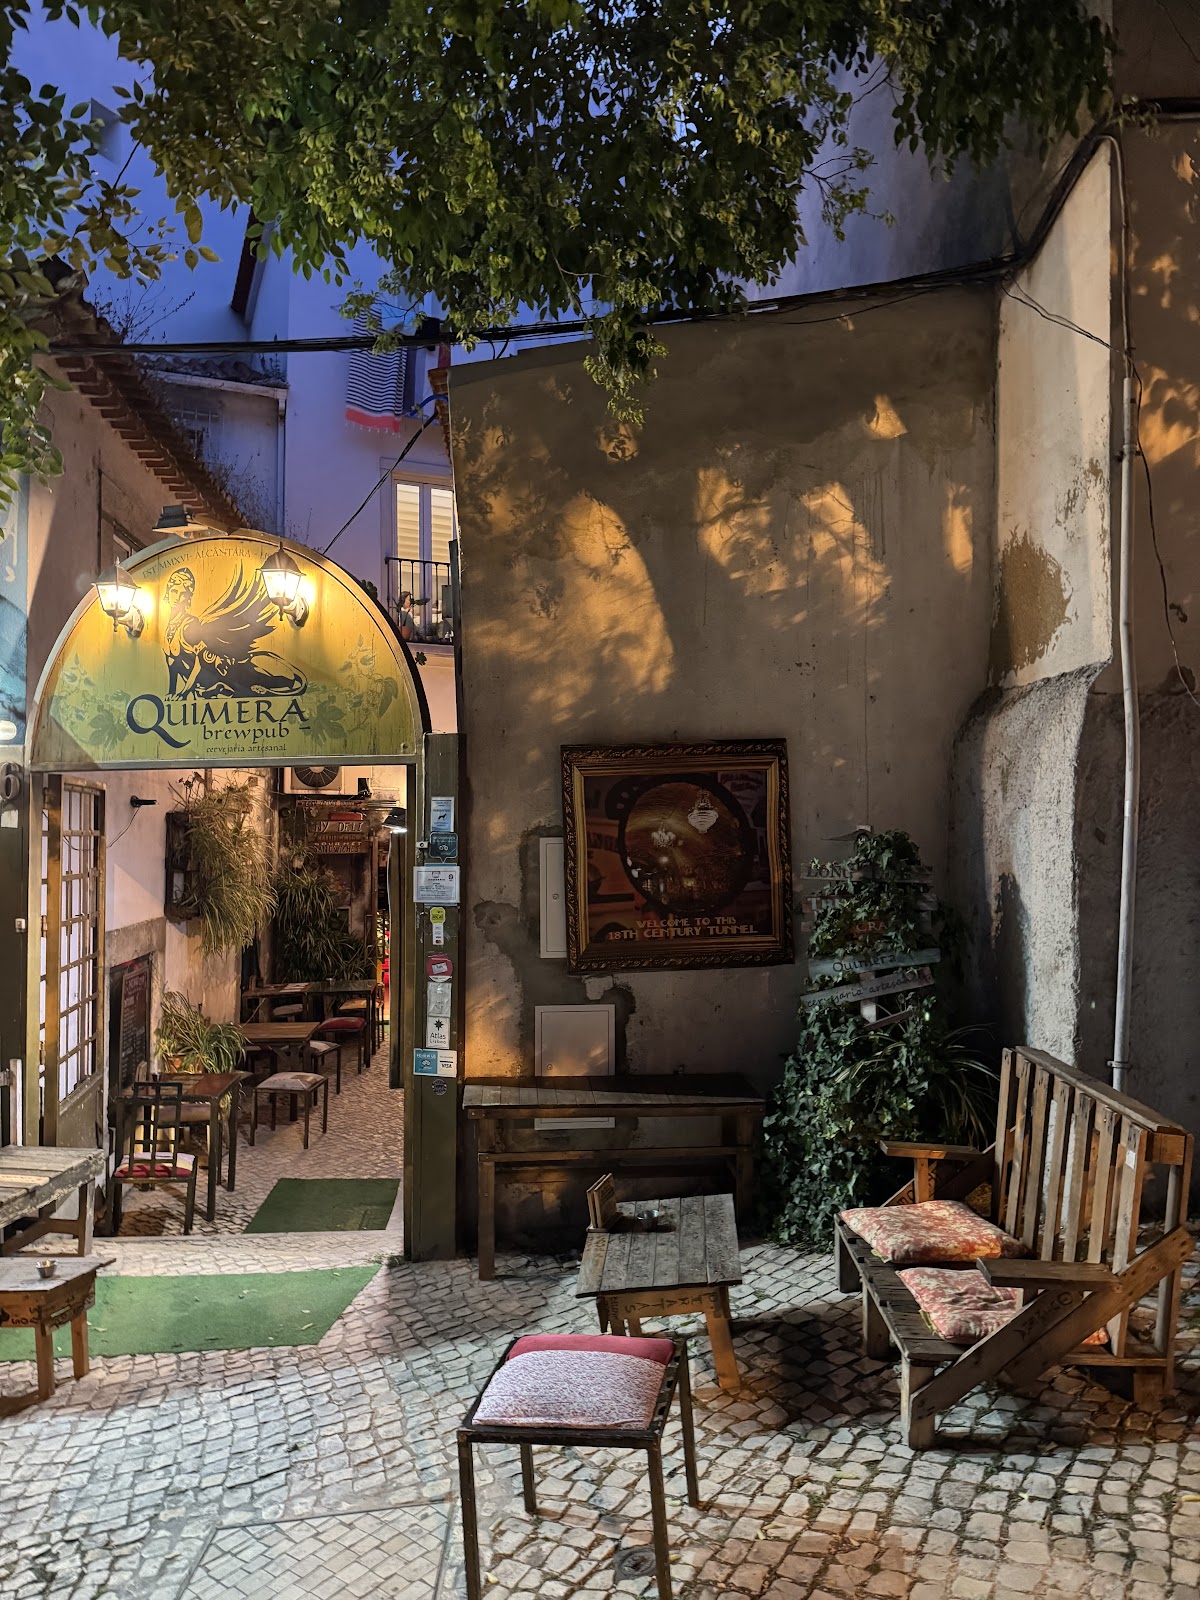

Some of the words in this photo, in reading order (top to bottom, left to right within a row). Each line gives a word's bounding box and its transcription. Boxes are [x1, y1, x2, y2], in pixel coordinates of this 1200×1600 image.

[126, 693, 310, 748] QUIMERA
[203, 723, 290, 744] brewpub
[206, 743, 245, 755] cervejaria
[247, 743, 287, 753] artesanal
[338, 821, 364, 832] DELI
[636, 917, 691, 929] WELCOME
[694, 917, 711, 926] TO
[714, 916, 737, 926] THIS
[608, 929, 639, 941] 18TH
[643, 926, 705, 939] CENTURY
[706, 925, 759, 936] TUNNEL
[430, 1031, 447, 1040] Atlas
